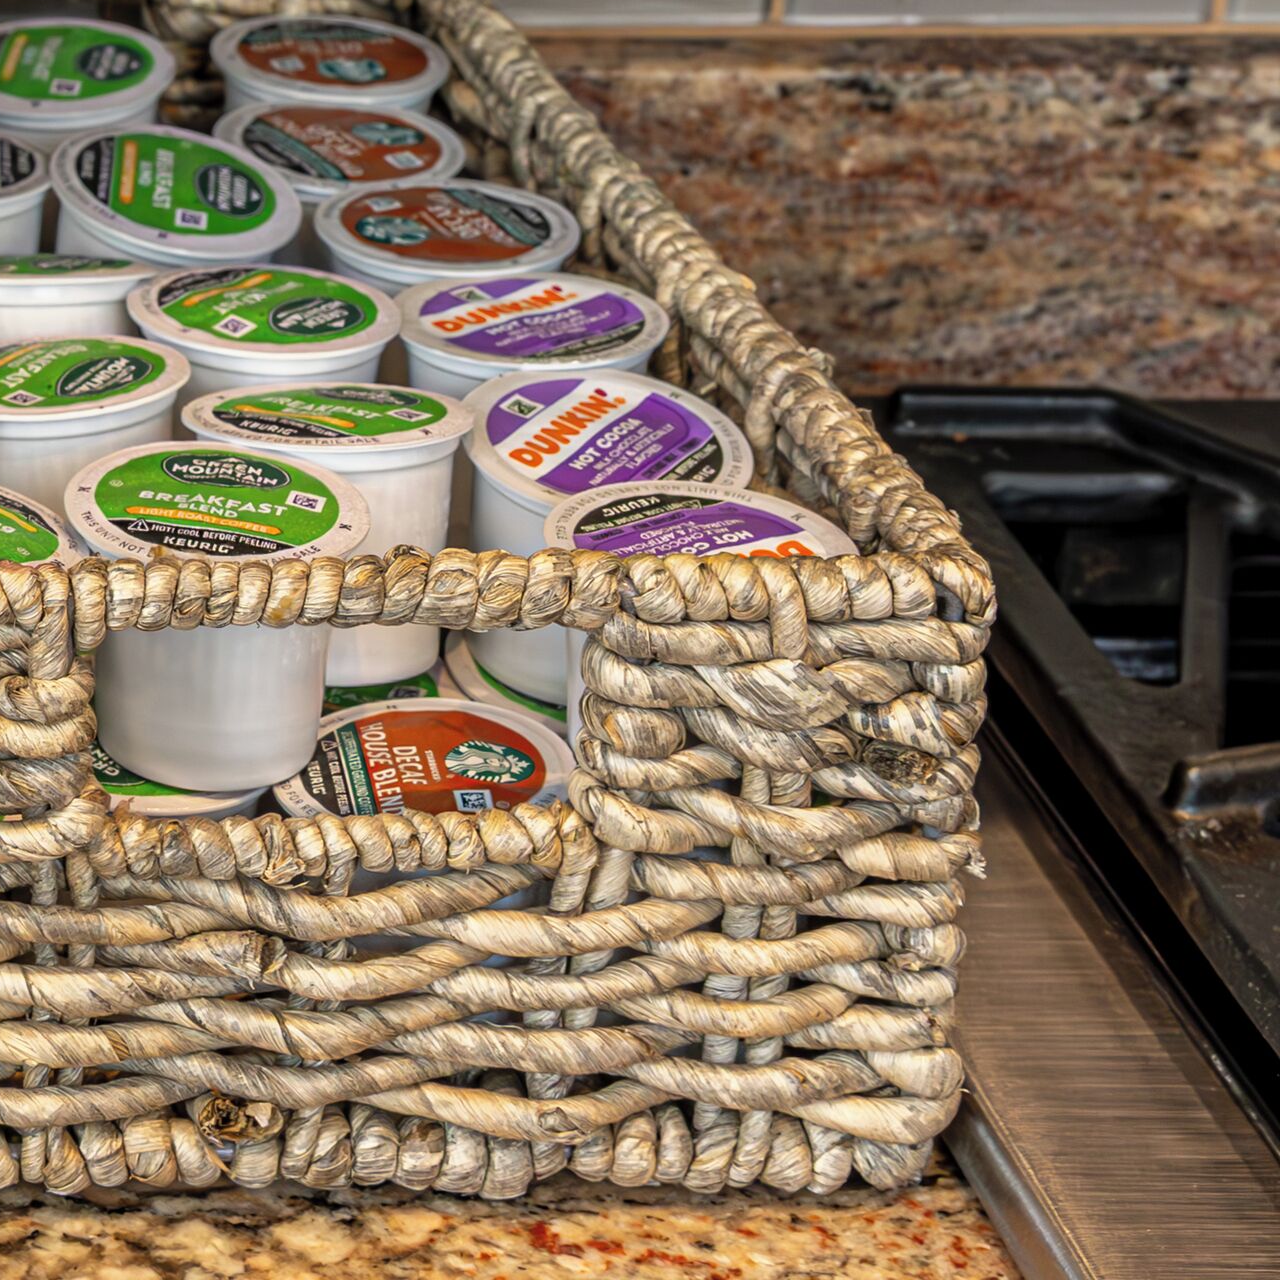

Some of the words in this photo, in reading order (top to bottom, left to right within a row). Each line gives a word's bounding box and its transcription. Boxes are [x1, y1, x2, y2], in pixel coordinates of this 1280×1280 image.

[431, 285, 566, 332] DUNKIN'
[260, 396, 385, 420] BREAKFAST
[240, 420, 298, 436] KEURIG
[508, 388, 618, 468] DUNKIN'
[568, 447, 601, 470] HOT
[596, 418, 643, 449] COCOA
[609, 425, 653, 458] CHOCOLATE
[172, 463, 278, 486] MOUNTAIN
[192, 458, 262, 476] GREEN
[138, 490, 288, 516] BREAKFAST
[177, 502, 238, 518] BLEND
[602, 496, 660, 517] KEURIG
[81, 511, 99, 527] THIS
[95, 526, 120, 542] UNIT
[118, 541, 145, 553] NOT
[140, 508, 174, 516] LIGHT
[177, 510, 214, 522] ROAST
[216, 517, 268, 533] COFFEE
[151, 524, 175, 533] HOT!
[177, 528, 200, 537] COOL
[202, 532, 237, 542] BEFORE
[239, 536, 277, 549] PEELING
[163, 536, 234, 554] KEURIG
[712, 530, 754, 545] HOT
[292, 545, 322, 558] SALE
[360, 722, 394, 767] HOUSE
[392, 745, 428, 785] DECAF
[424, 749, 442, 782] STARBUCKS
[332, 775, 346, 794] BEFORE
[351, 769, 369, 797] GROUND
[372, 767, 405, 816] BLEND
[286, 791, 304, 805] FOR
